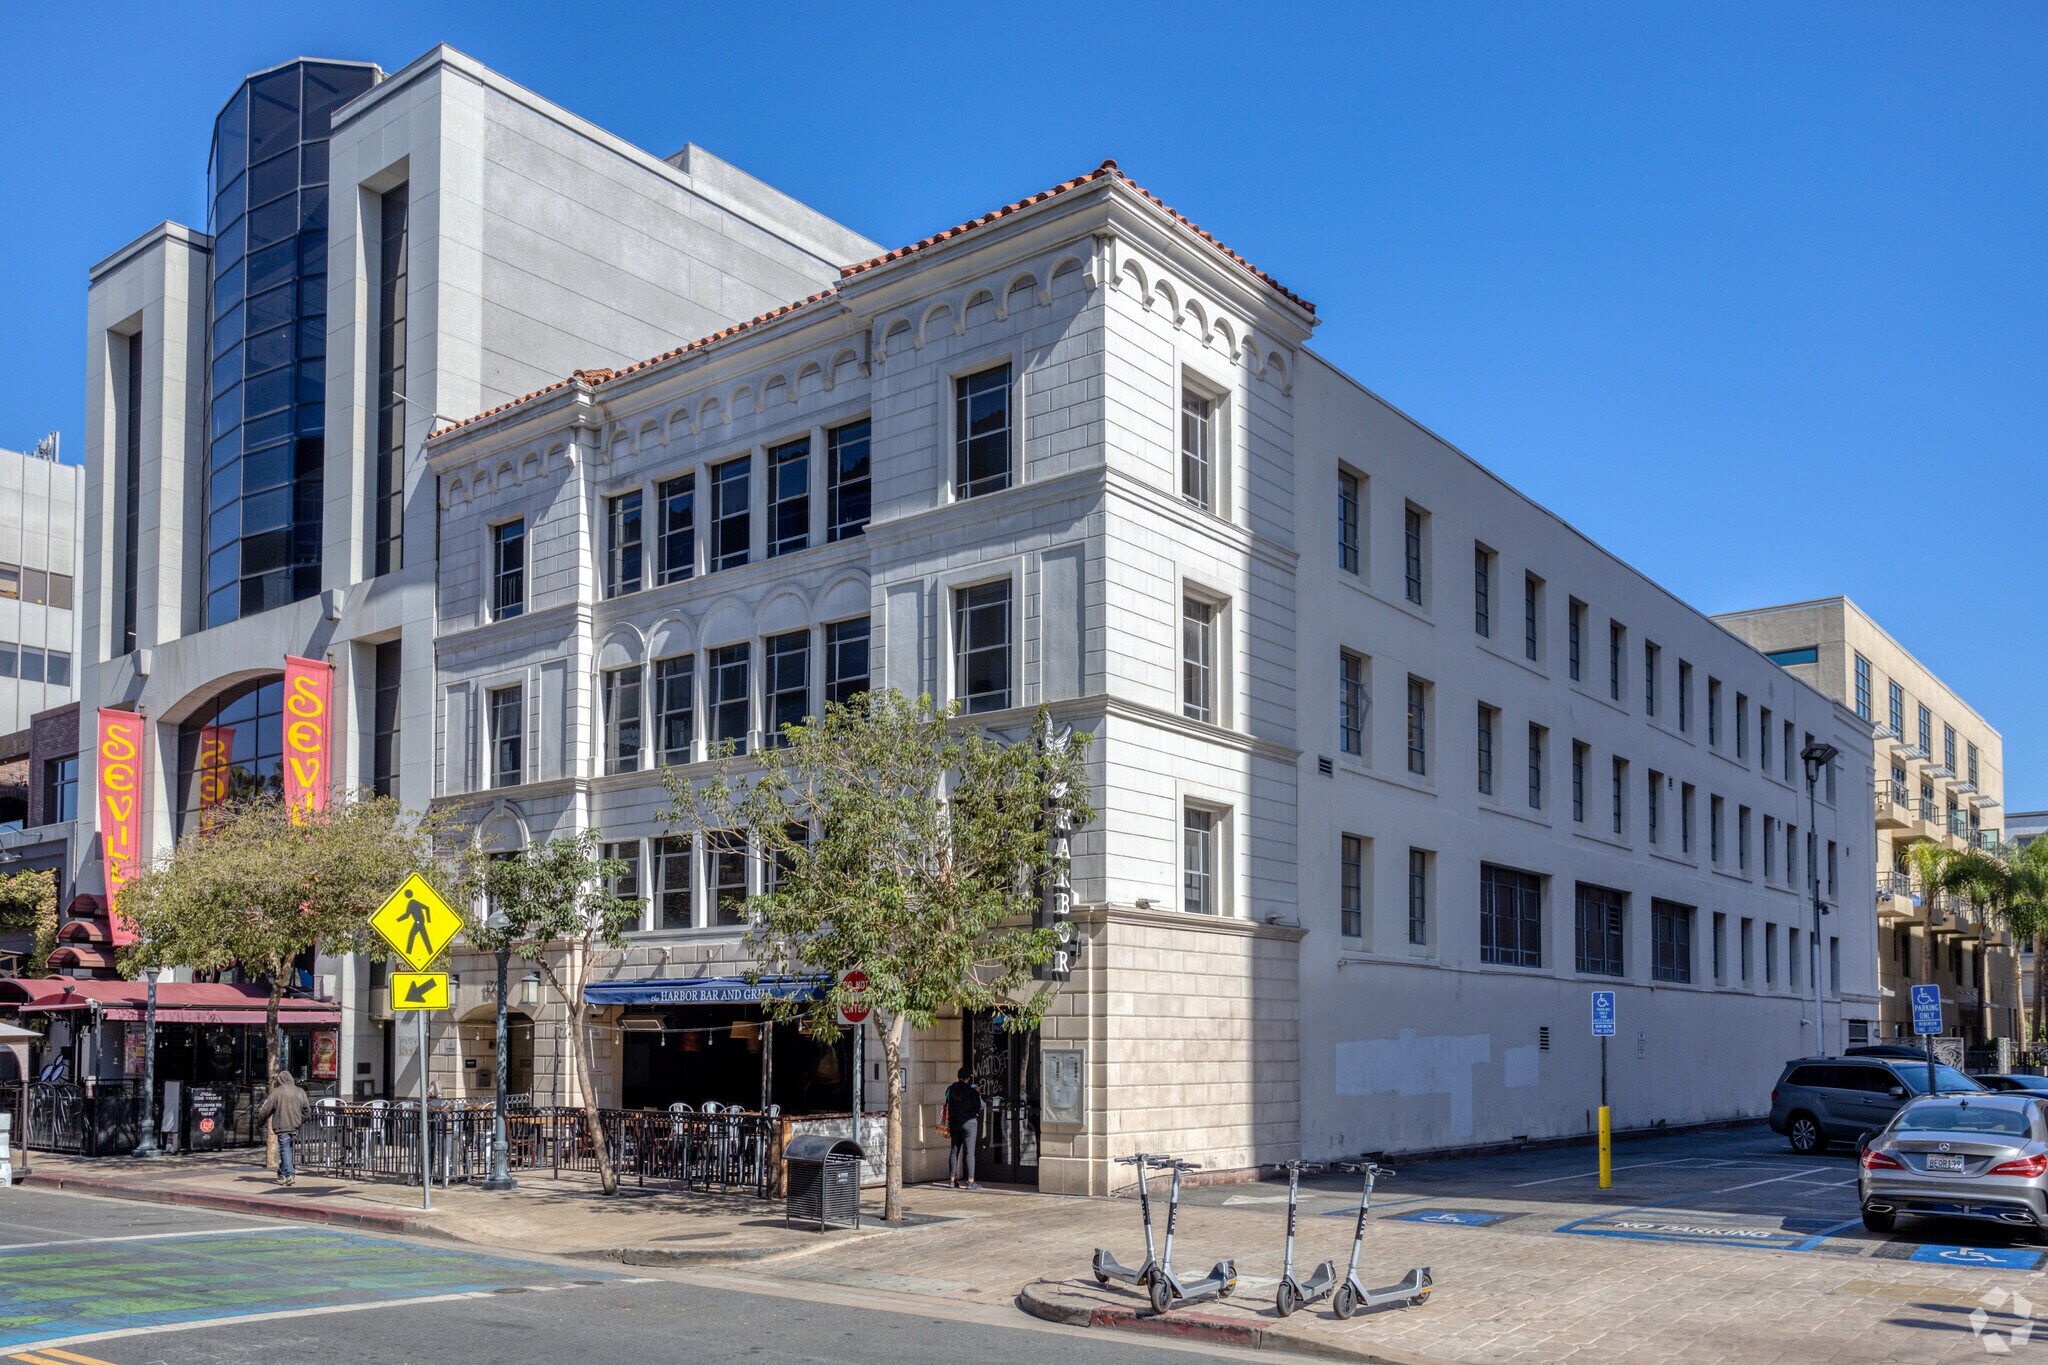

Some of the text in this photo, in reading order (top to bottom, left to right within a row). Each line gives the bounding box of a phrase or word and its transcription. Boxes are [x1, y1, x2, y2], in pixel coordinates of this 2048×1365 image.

[843, 980, 869, 990] DO NOT
[660, 990, 698, 1002] HARBOR
[700, 990, 719, 1001] BAR
[720, 990, 742, 1000] AND
[1914, 1004, 1938, 1012] PARKING
[1920, 1012, 1935, 1020] ONLY
[1657, 1225, 1772, 1238] PARKING
